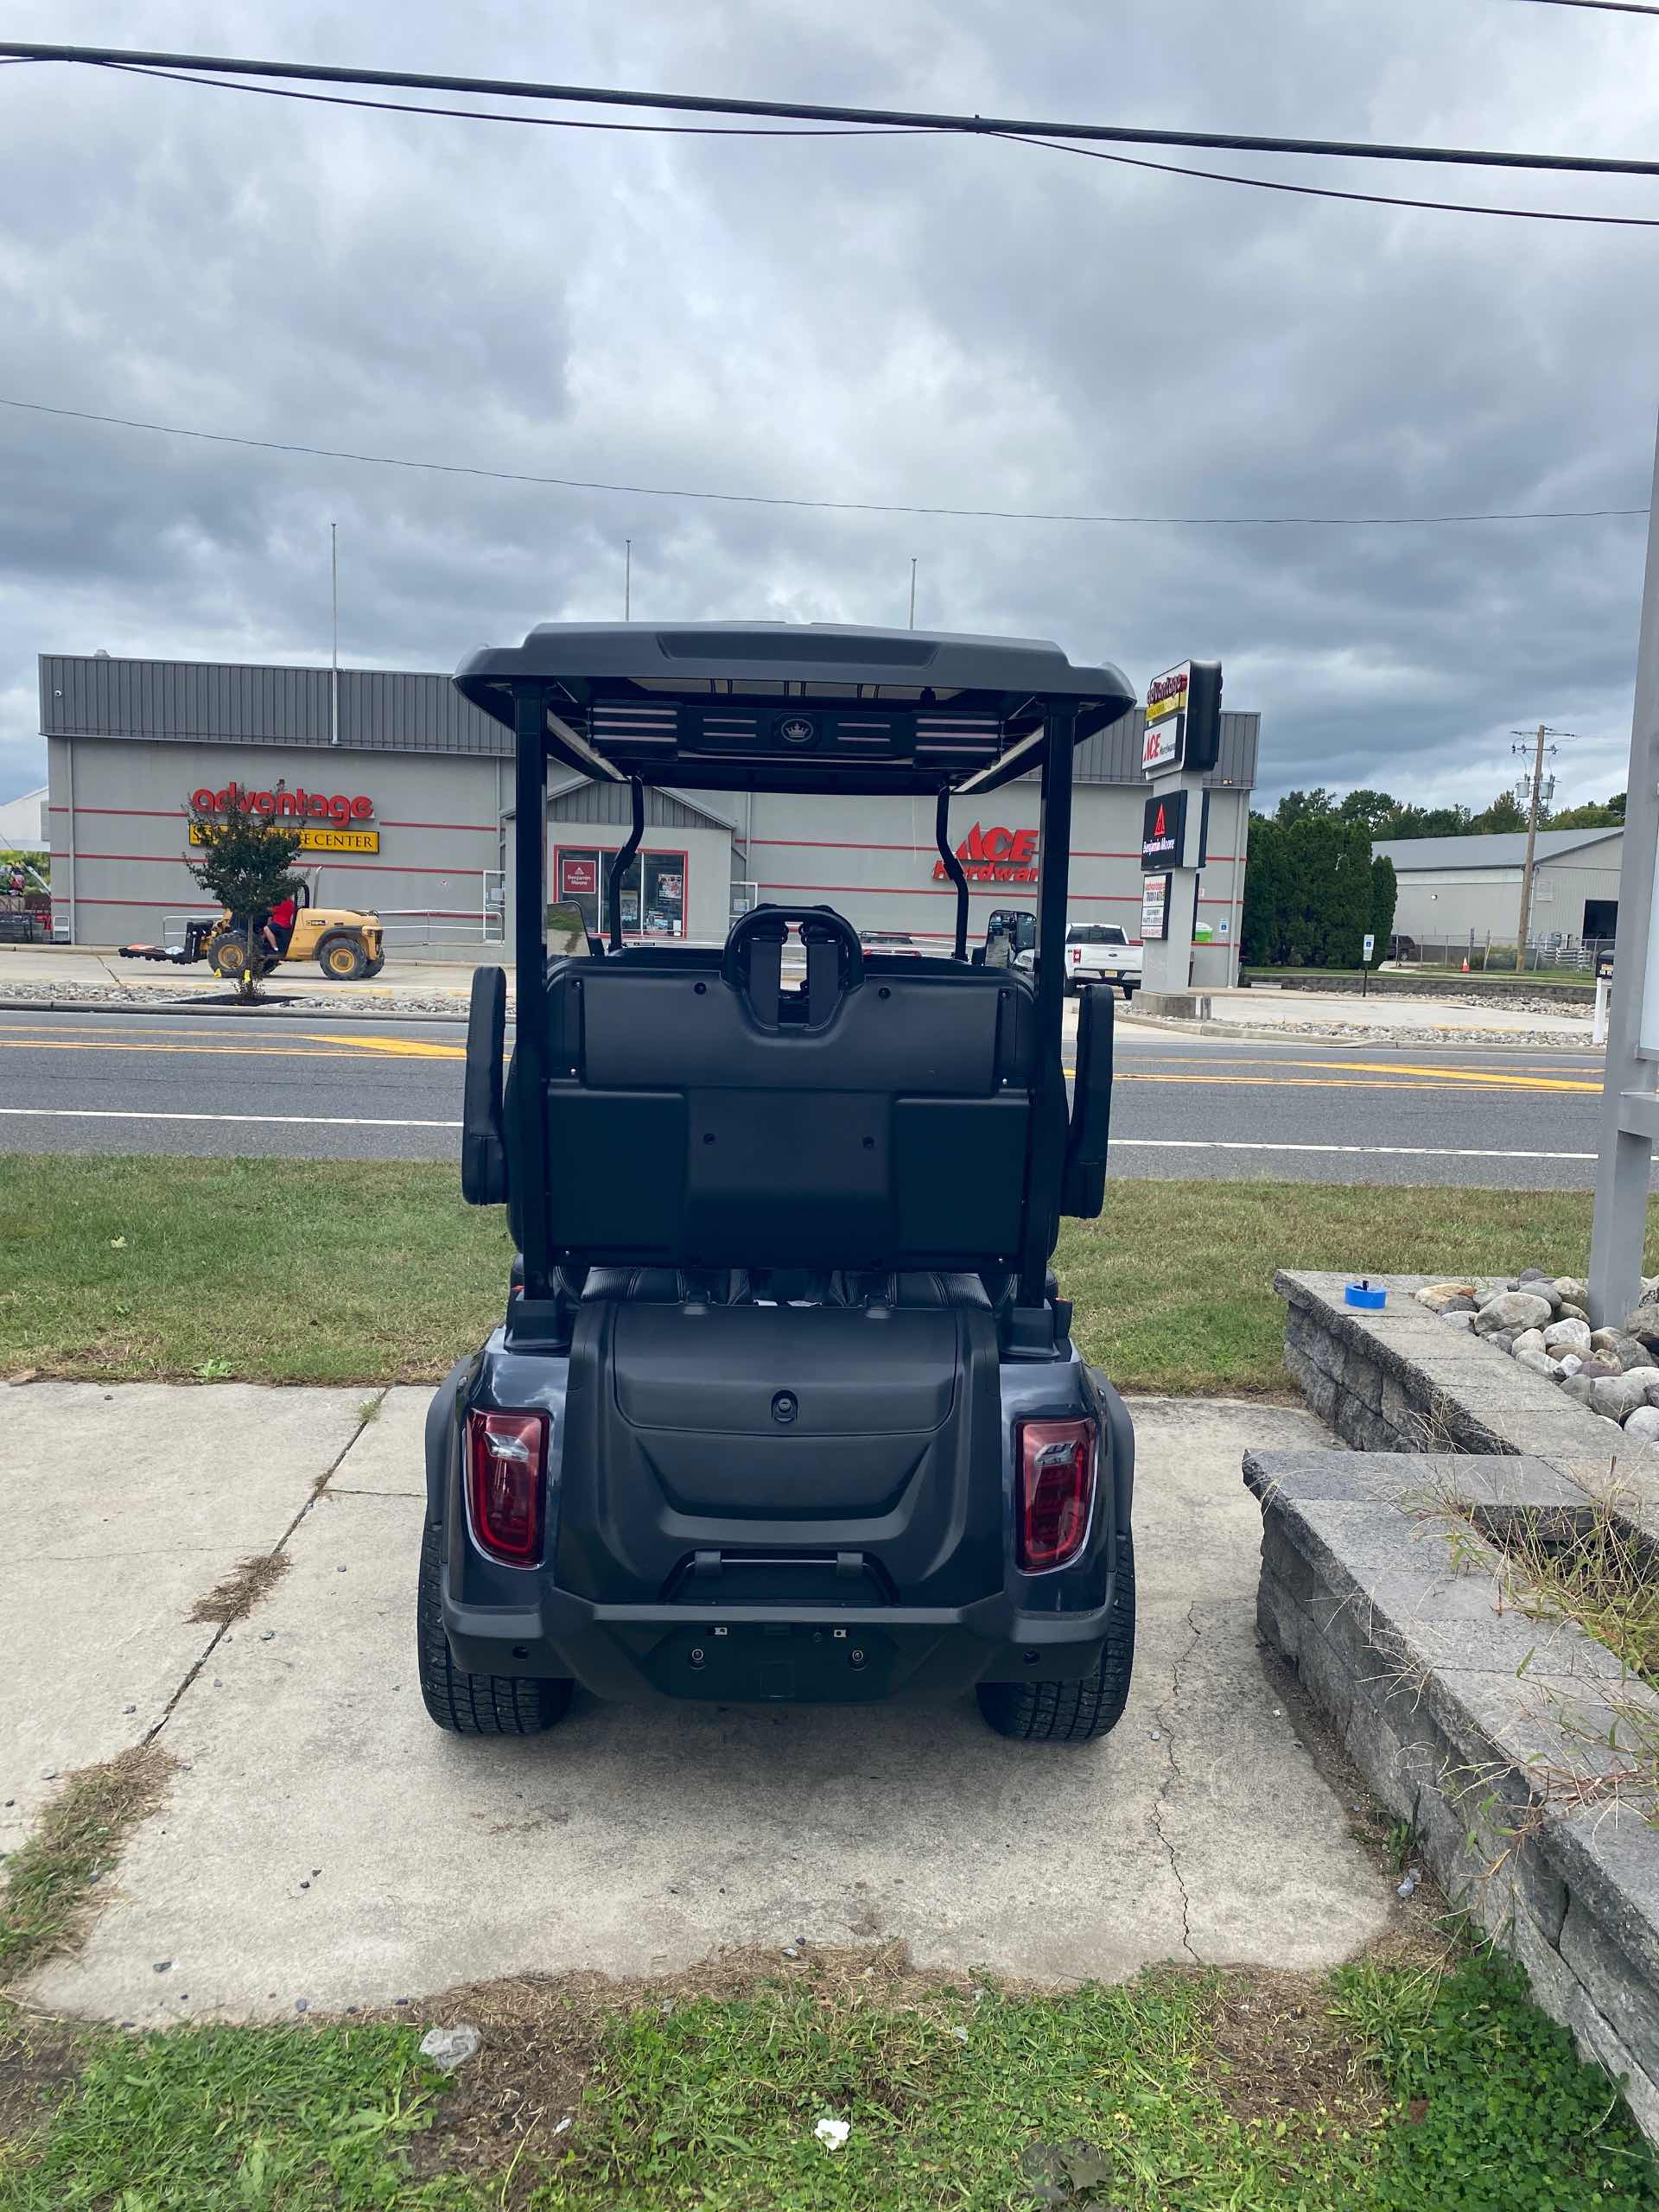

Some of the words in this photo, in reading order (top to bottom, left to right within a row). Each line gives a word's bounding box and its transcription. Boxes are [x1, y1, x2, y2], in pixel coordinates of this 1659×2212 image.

[1143, 733, 1161, 761] ACE
[192, 782, 373, 827] advantage
[315, 832, 373, 848] CENTER
[957, 821, 1039, 864] ACE
[932, 860, 1039, 883] Hrdwar
